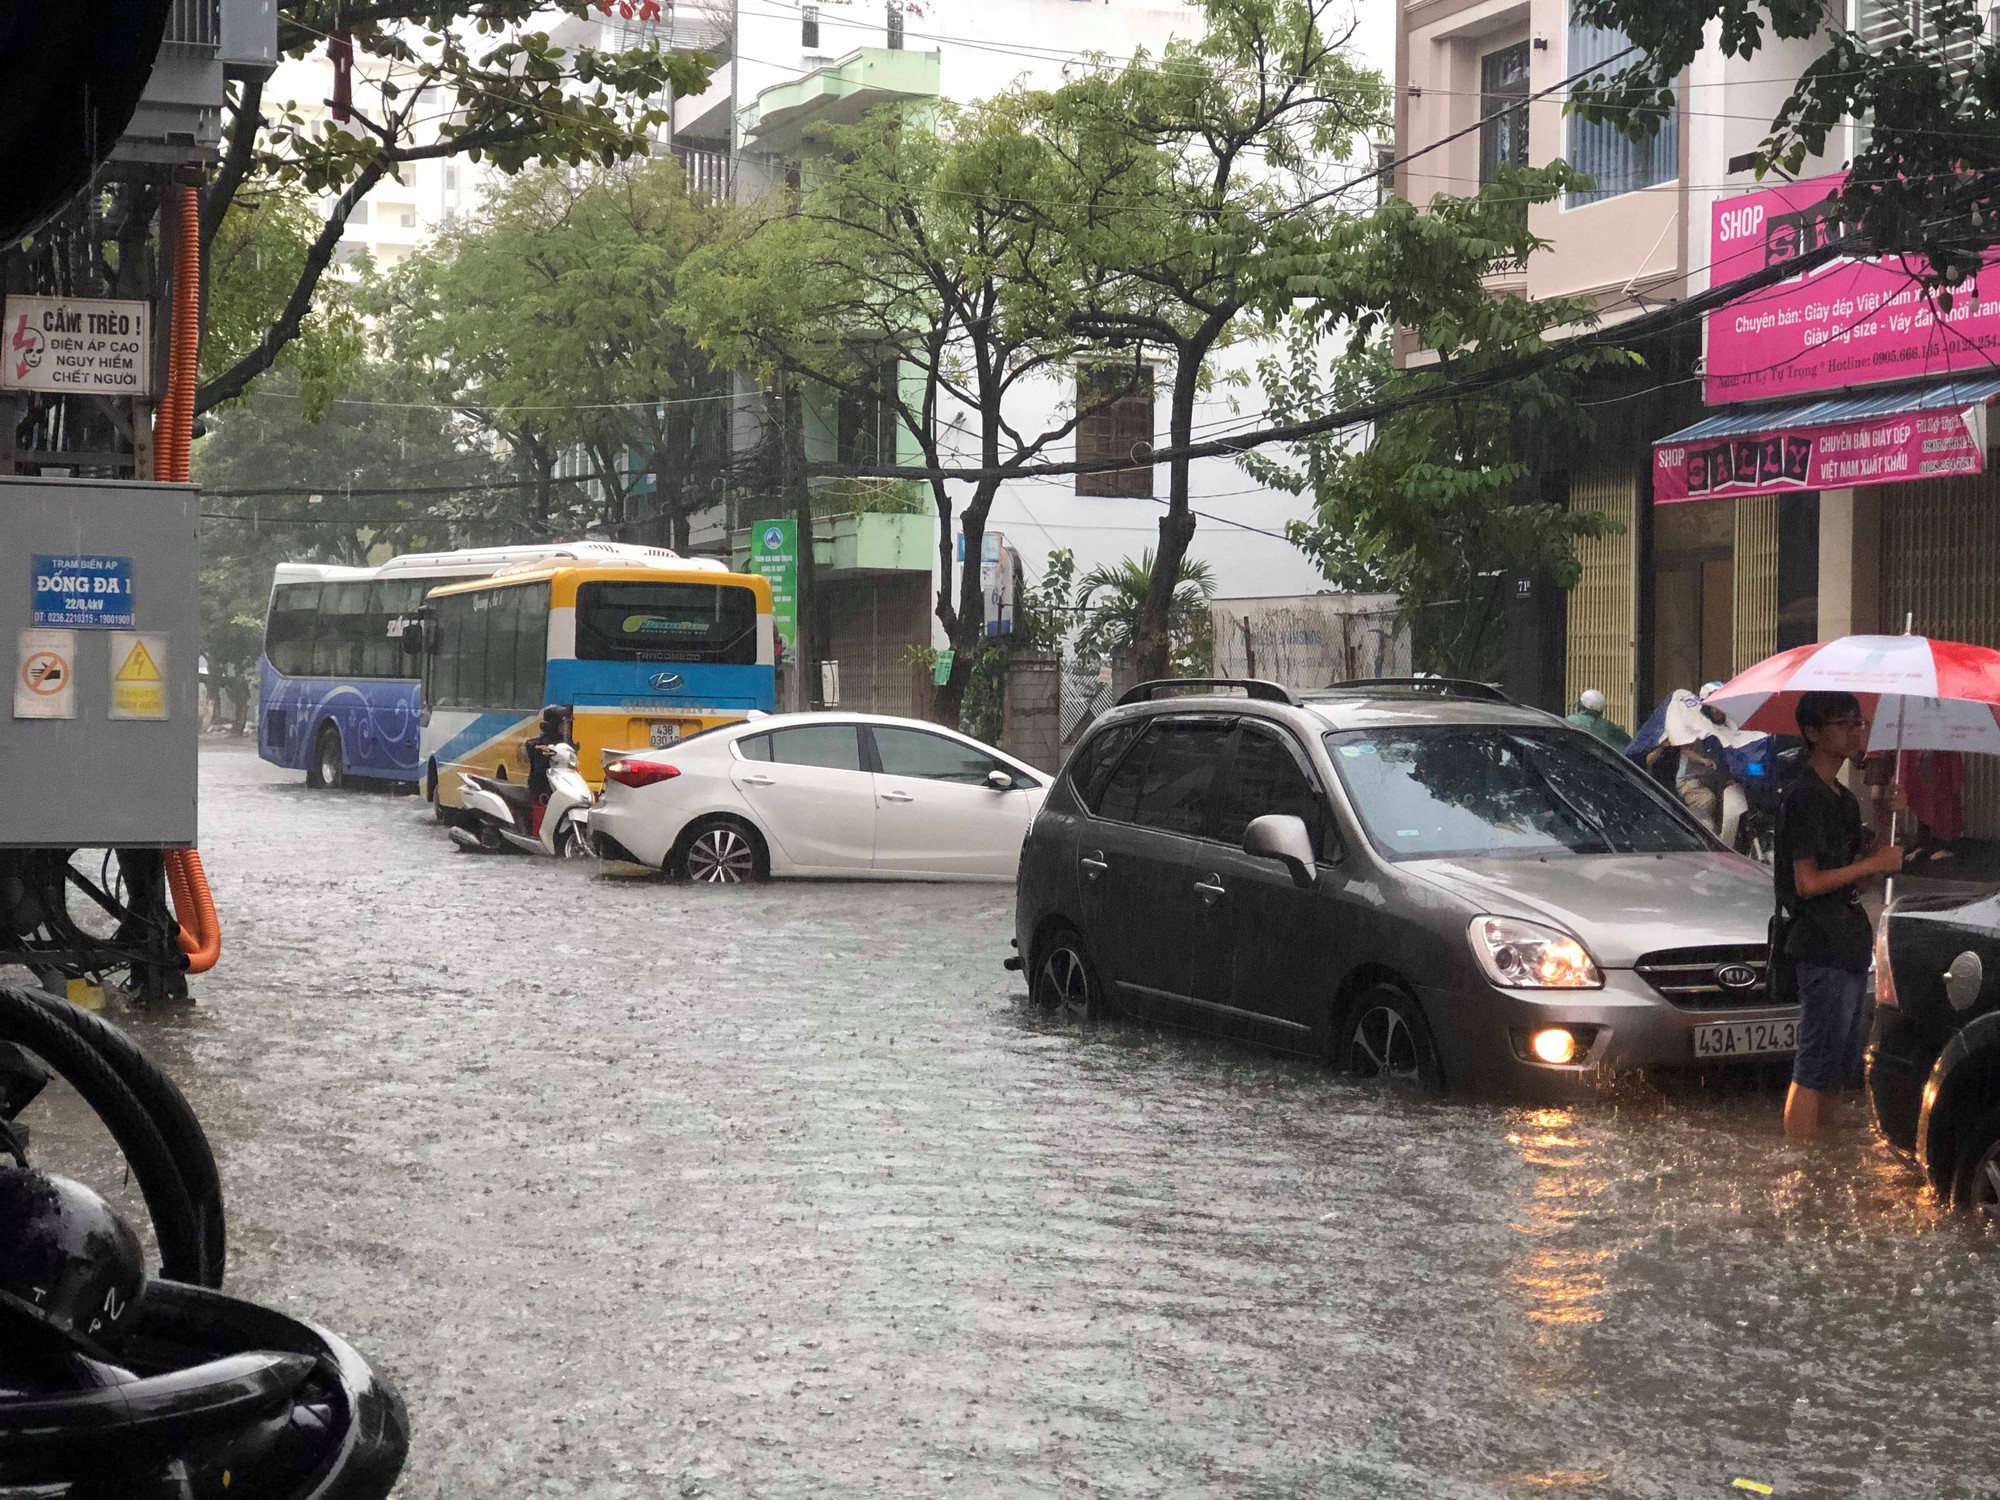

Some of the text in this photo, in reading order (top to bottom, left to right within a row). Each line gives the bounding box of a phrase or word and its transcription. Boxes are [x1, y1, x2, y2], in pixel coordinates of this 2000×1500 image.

[1720, 204, 1763, 242] SHOP
[43, 305, 82, 333] CẤM
[88, 310, 129, 335] TRÈO
[1735, 312, 1775, 333] Chuyên
[1778, 307, 1802, 326] bán:
[1804, 302, 1830, 322] Giày
[1832, 298, 1853, 318] dép
[1856, 291, 1880, 313] Việt
[1881, 290, 1911, 308] Nam
[1804, 328, 1829, 347] Giày
[1832, 323, 1850, 344] Big
[1853, 321, 1877, 338] size
[1889, 313, 1912, 334] Váy
[51, 337, 139, 353] ĐIỆN ÁP CAO
[57, 354, 133, 368] NGUY HIỂM
[1828, 356, 1871, 373] Hotline:
[52, 369, 136, 385] CHẾT NGƯỜI
[1786, 364, 1817, 379] Trọng
[1820, 423, 1910, 453] CHUYÊN BÁN GIÀY DÉP
[1658, 447, 1685, 468] SHOP
[1820, 447, 1908, 482] VIỆT NAM XUẤT KHẨU
[52, 559, 78, 570] TRẠM
[81, 559, 102, 569] BIẾN
[37, 570, 90, 593] ĐỐNG
[94, 577, 120, 594] ĐA
[657, 725, 673, 736] 43B
[1724, 970, 1750, 981] KIA
